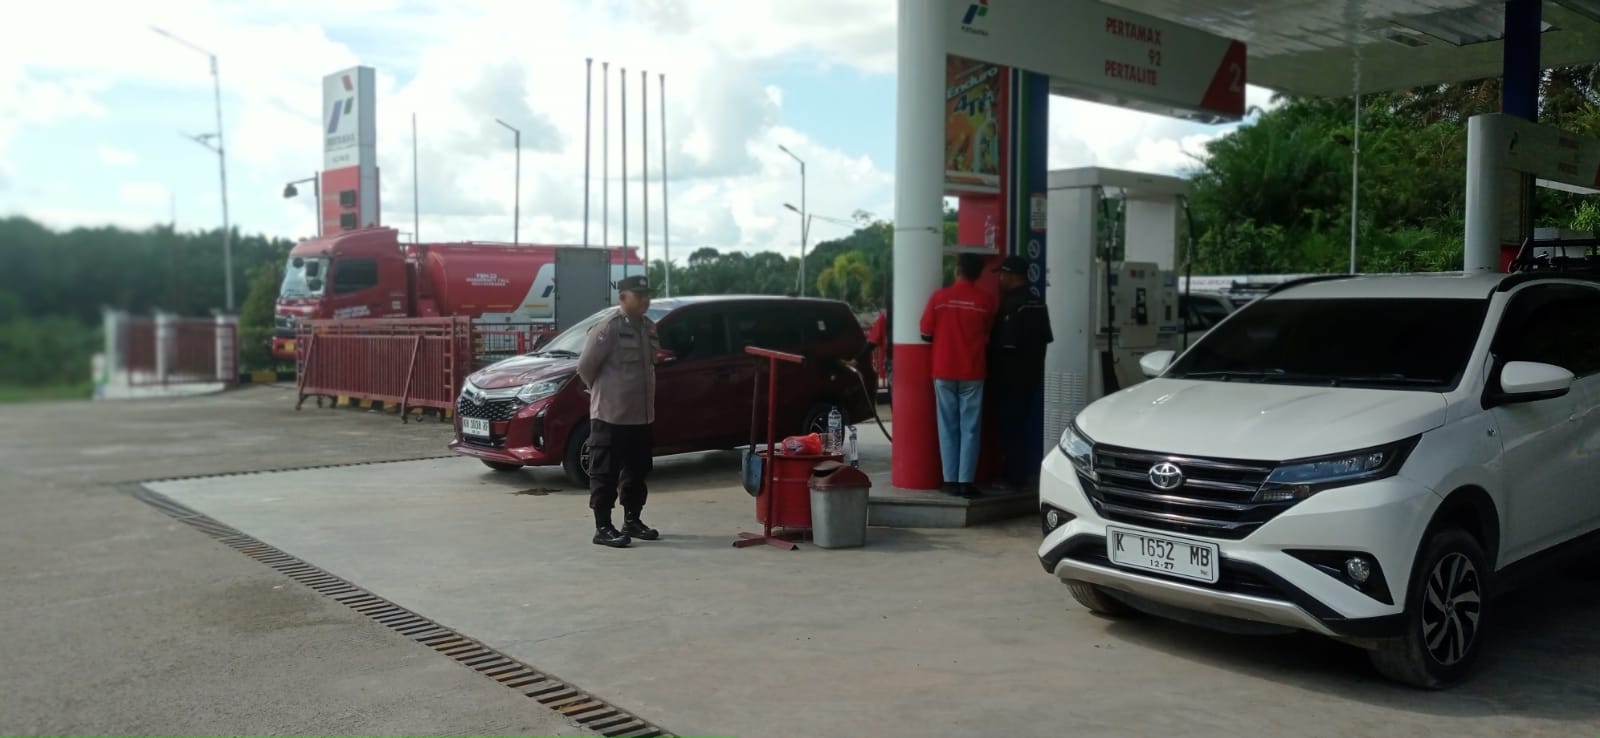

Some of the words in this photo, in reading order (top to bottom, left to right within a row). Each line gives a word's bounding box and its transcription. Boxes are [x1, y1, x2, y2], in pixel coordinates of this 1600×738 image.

[1106, 17, 1161, 45] PERTAMAX
[1149, 49, 1161, 66] 92
[946, 67, 998, 99] Enduro
[1105, 60, 1157, 86] PERTALITE
[1229, 63, 1241, 92] 2
[1116, 533, 1125, 552] K
[1140, 537, 1175, 560] 1652
[1190, 546, 1210, 566] MB
